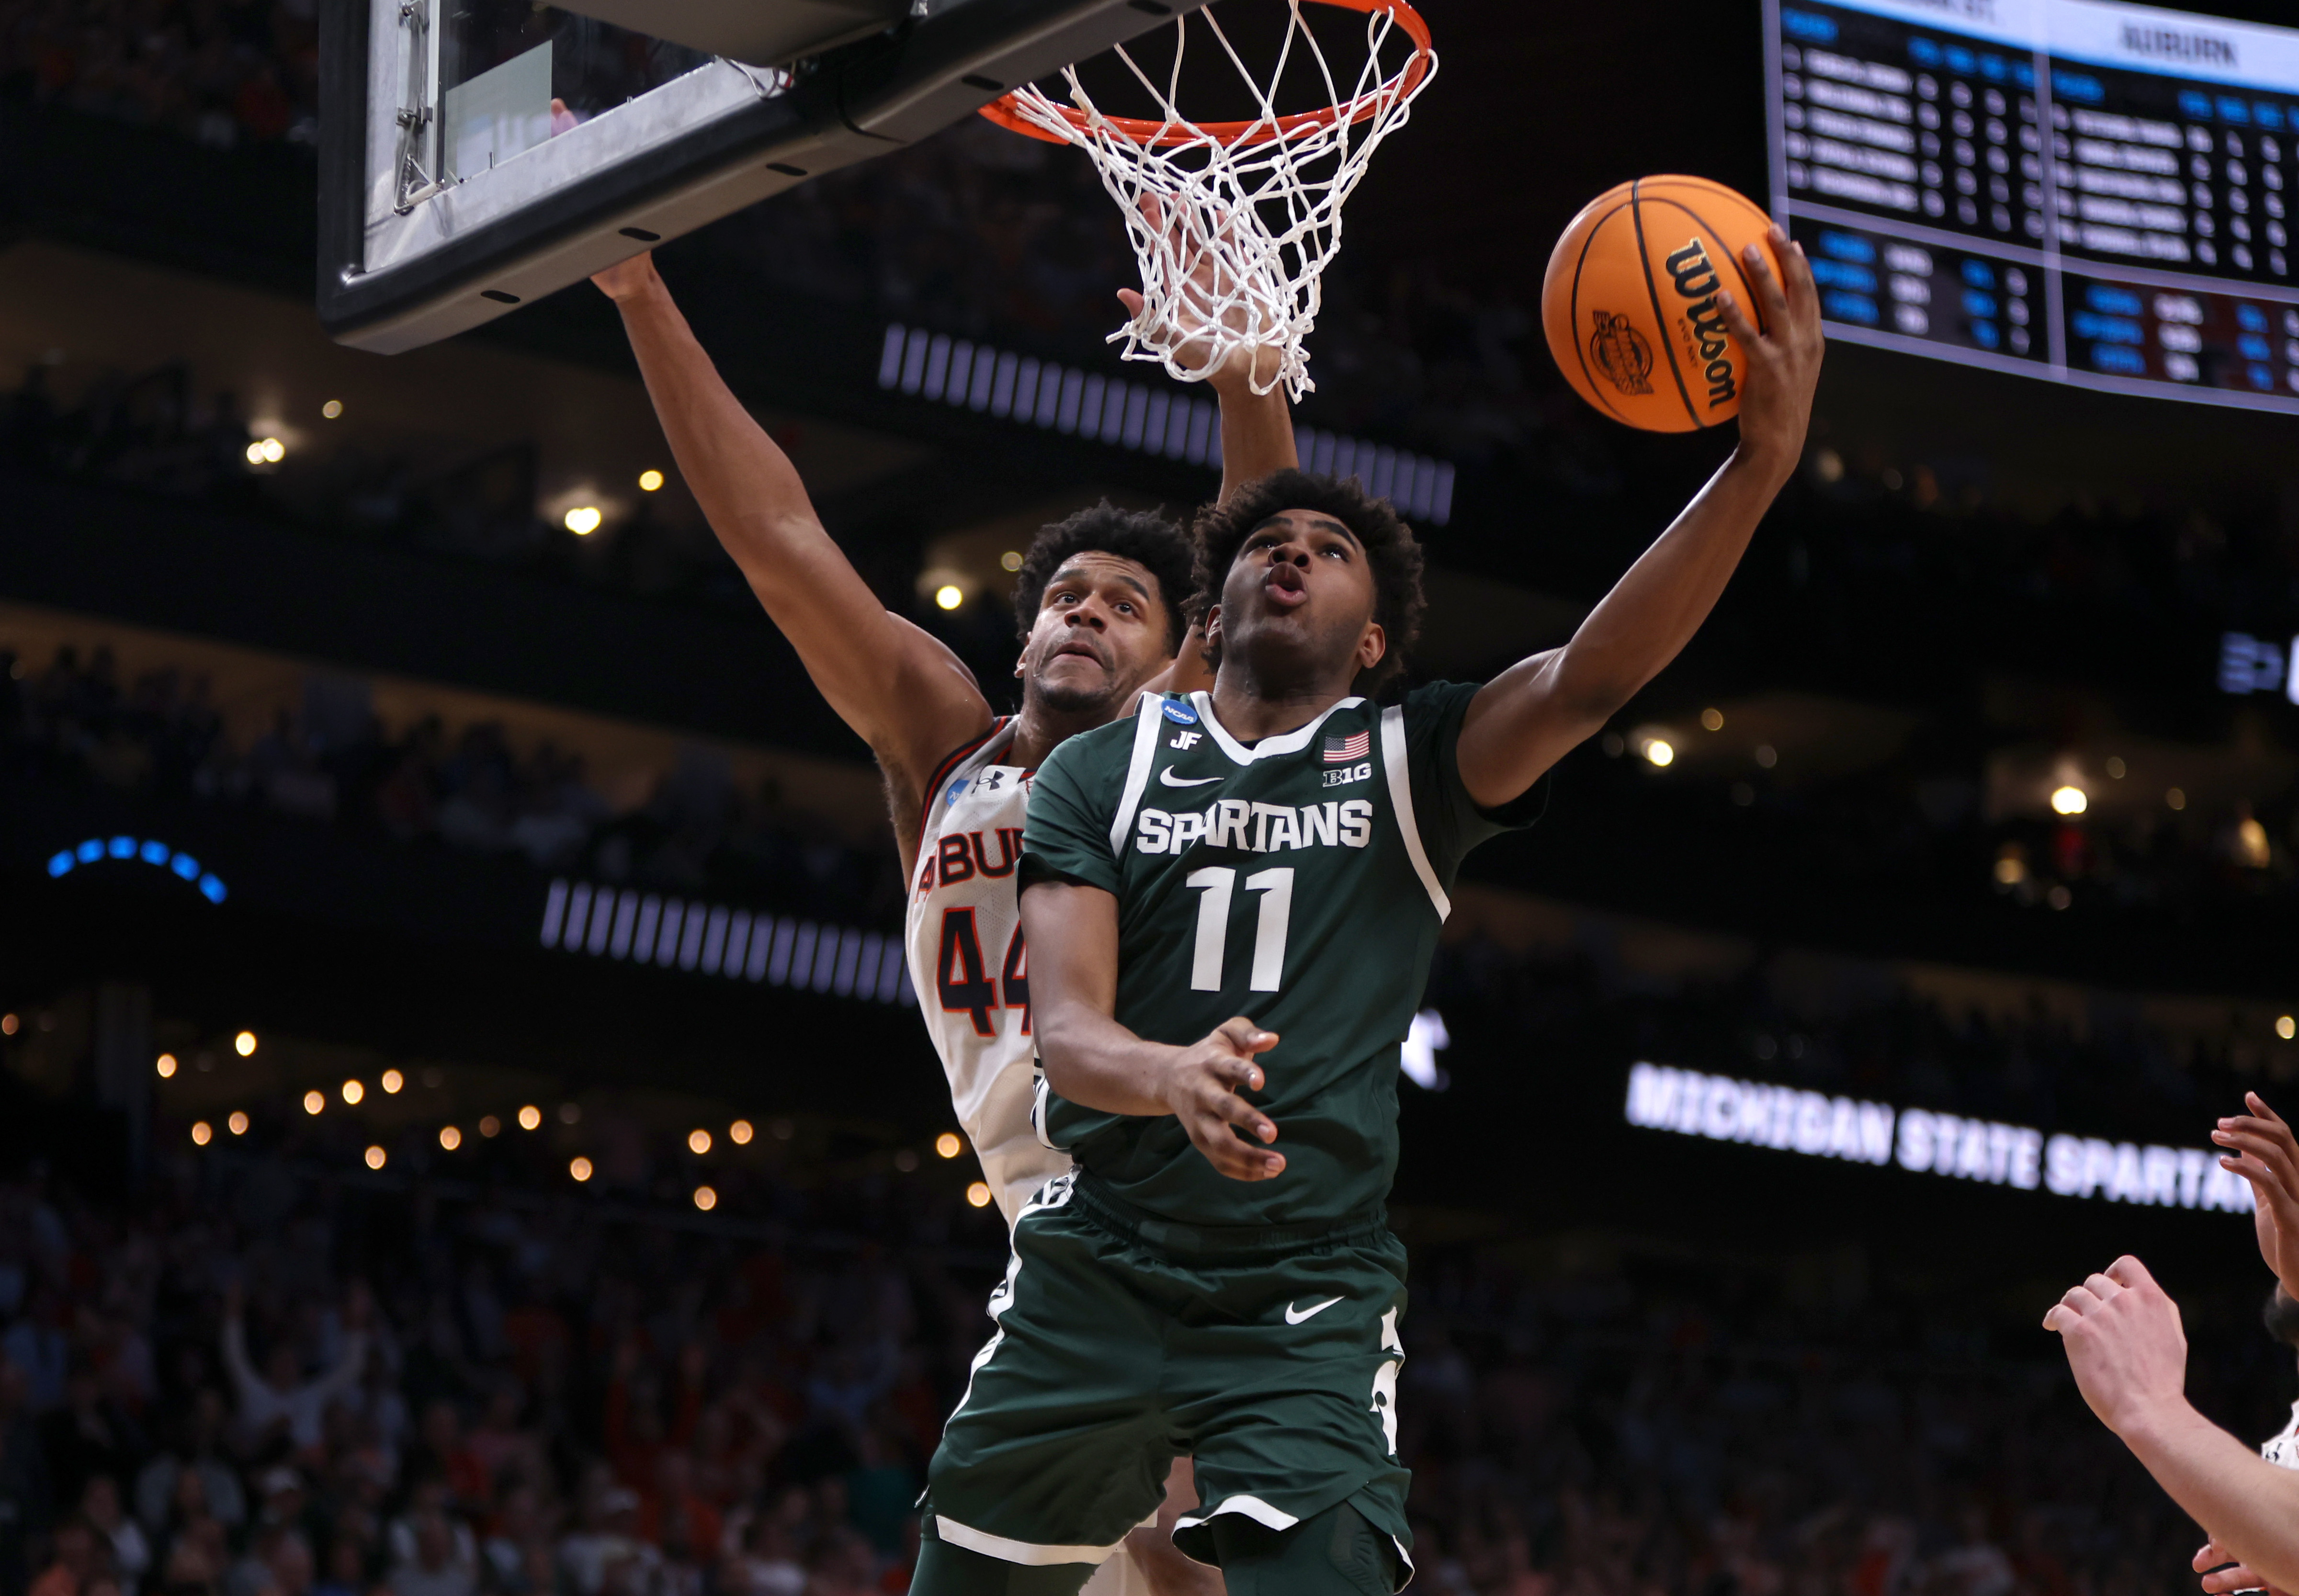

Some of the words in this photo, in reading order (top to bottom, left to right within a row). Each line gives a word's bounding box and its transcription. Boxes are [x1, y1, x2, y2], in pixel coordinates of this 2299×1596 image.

[1666, 237, 1736, 407] Wilson
[1164, 706, 1195, 723] NCAA
[1170, 731, 1202, 750] JF
[1137, 799, 1372, 855] SPARTANS
[937, 906, 1032, 1037] 44
[1186, 866, 1295, 992] 11
[1627, 1062, 1895, 1166] MICHIGAN
[1896, 1108, 2043, 1190] STATE
